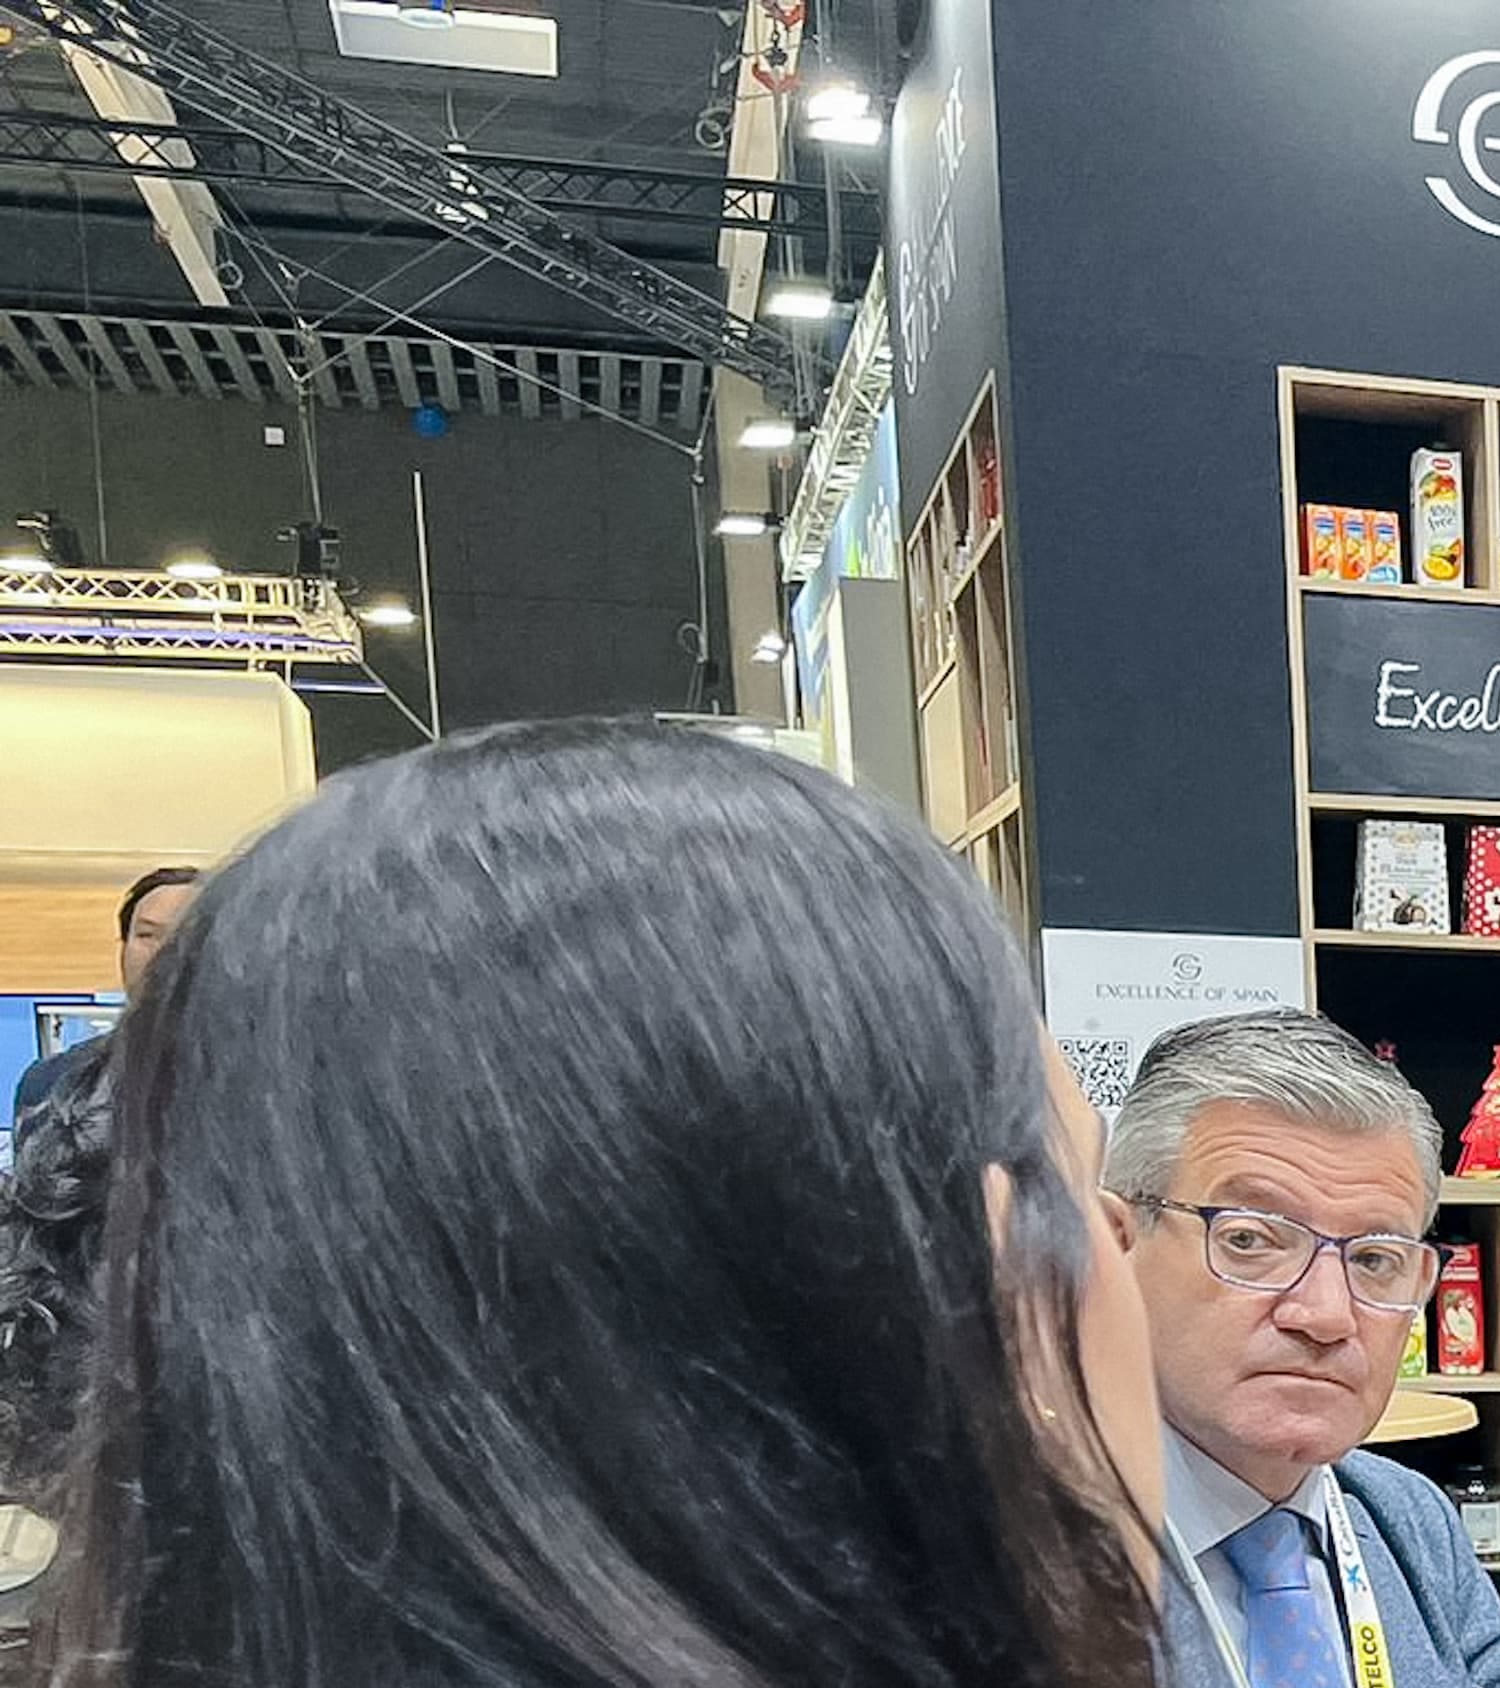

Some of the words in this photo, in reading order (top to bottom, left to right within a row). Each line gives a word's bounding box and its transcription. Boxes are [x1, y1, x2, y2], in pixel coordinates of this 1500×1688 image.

[1095, 983, 1196, 1000] EXCELLENCE
[1204, 986, 1227, 1001] OF
[1232, 988, 1280, 1002] SPAIN
